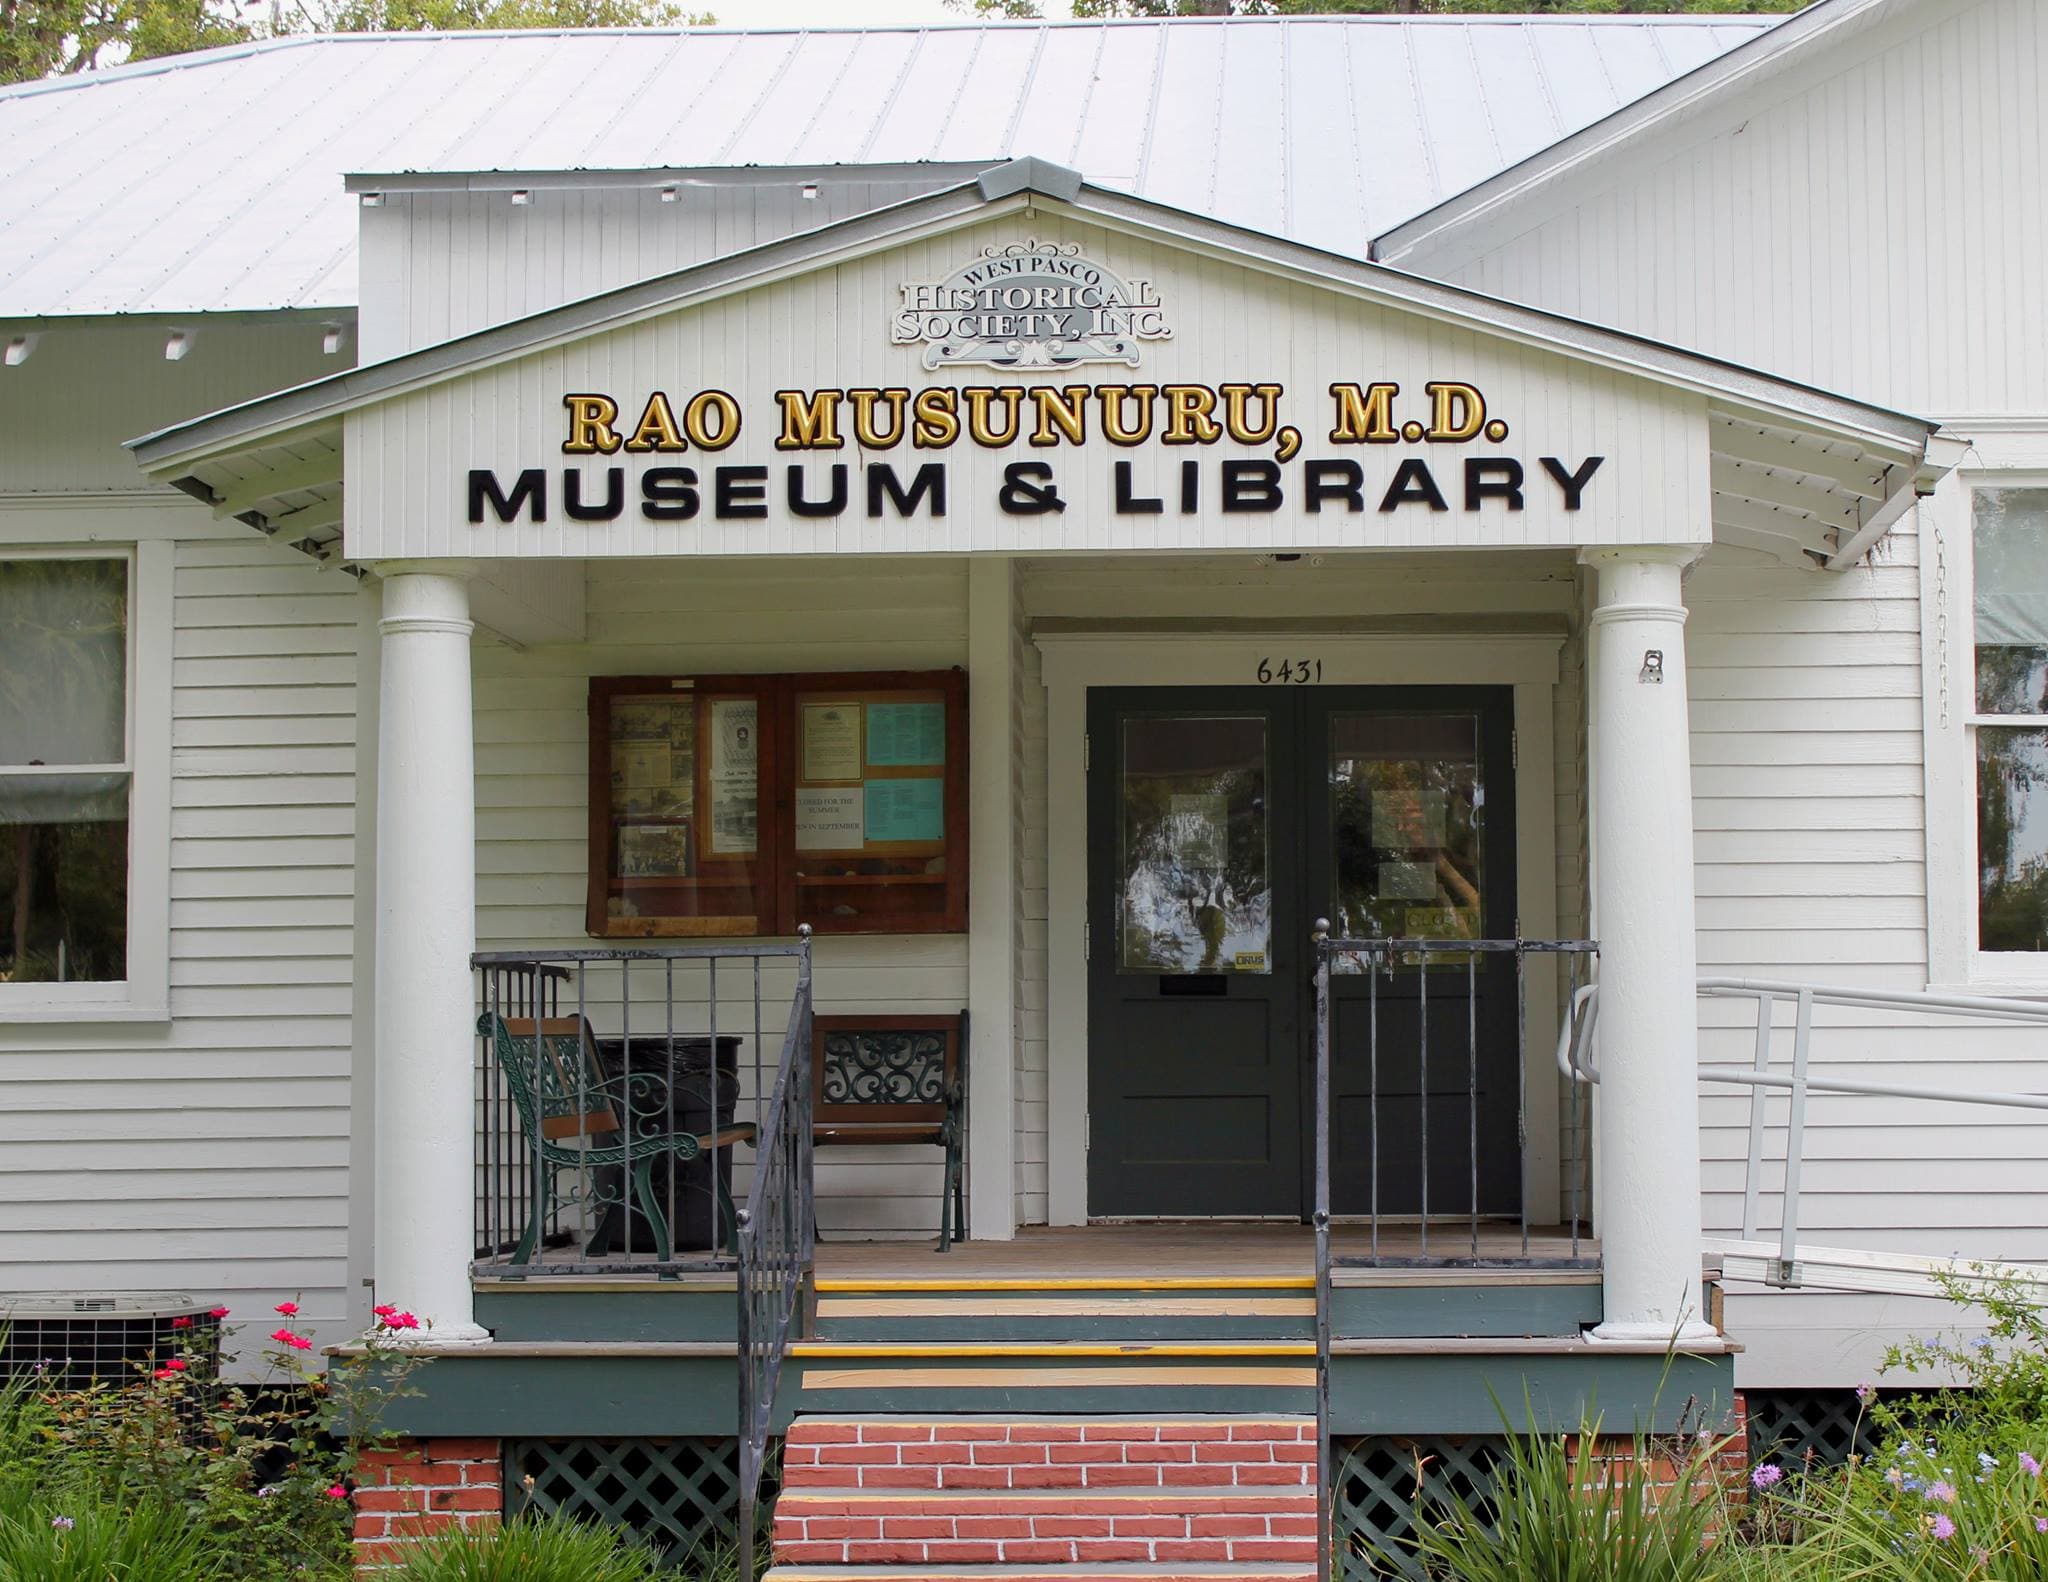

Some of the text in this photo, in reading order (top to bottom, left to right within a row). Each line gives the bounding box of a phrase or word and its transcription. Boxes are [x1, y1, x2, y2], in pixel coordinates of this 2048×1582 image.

[963, 257, 1101, 287] WEST PASCO
[906, 281, 1161, 312] HISTORICAL
[895, 308, 1172, 340] SOCIETY, INC.
[562, 382, 1509, 465] RAO MUSUNURU, M.D.
[468, 456, 1605, 525] MUSEUM & LIBRARY
[1256, 657, 1323, 684] 6431
[798, 798, 822, 806] LOSED
